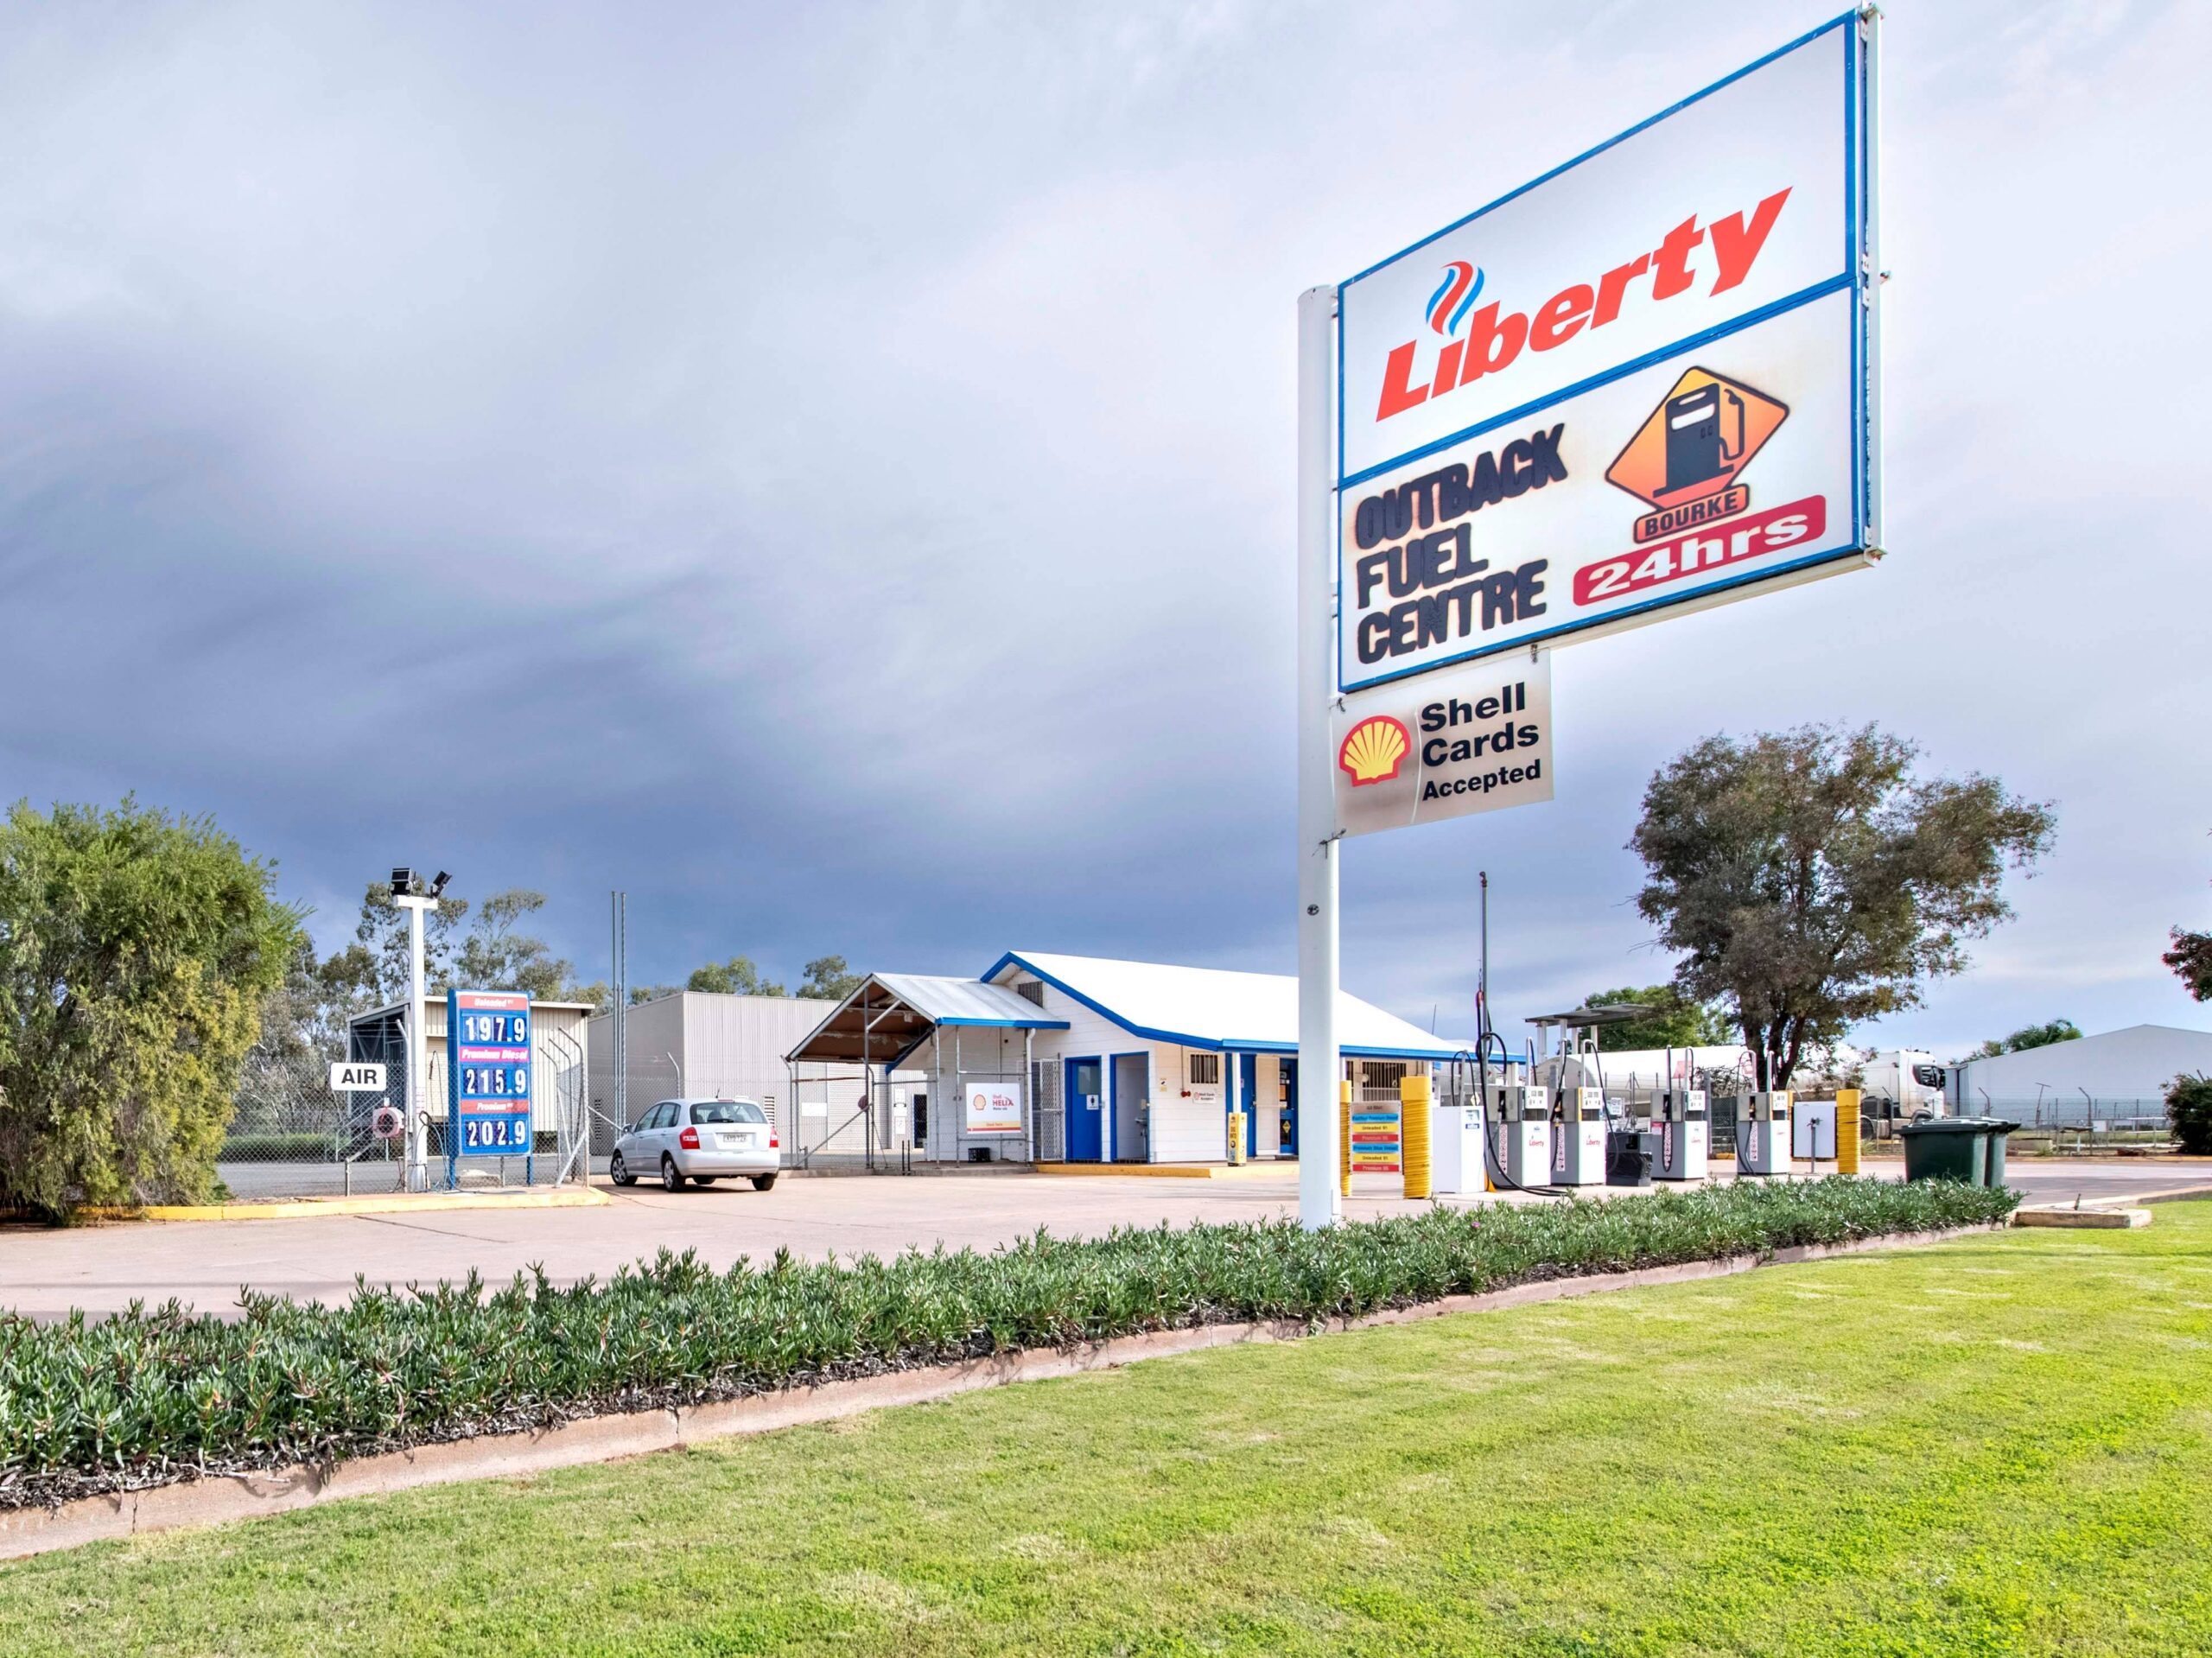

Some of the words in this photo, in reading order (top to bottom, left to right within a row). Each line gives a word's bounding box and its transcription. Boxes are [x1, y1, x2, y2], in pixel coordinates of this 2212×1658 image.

[1376, 186, 1793, 422] Liberty
[1355, 422, 1568, 549] OUTBACK
[1645, 492, 1738, 537] BOURKE
[1357, 522, 1489, 609] FUEL
[1587, 514, 1808, 599] 24hrs
[1357, 558, 1548, 664] CENTRE
[1421, 682, 1525, 732] Shell
[1421, 721, 1540, 767] Cards
[1421, 759, 1541, 802] Accepted
[465, 1016, 525, 1043] 197.9
[341, 1069, 377, 1084] AIR
[461, 1048, 501, 1059] Premium
[501, 1050, 528, 1060] Diesel
[467, 1068, 526, 1095] 215.9
[468, 1120, 526, 1147] 202.9
